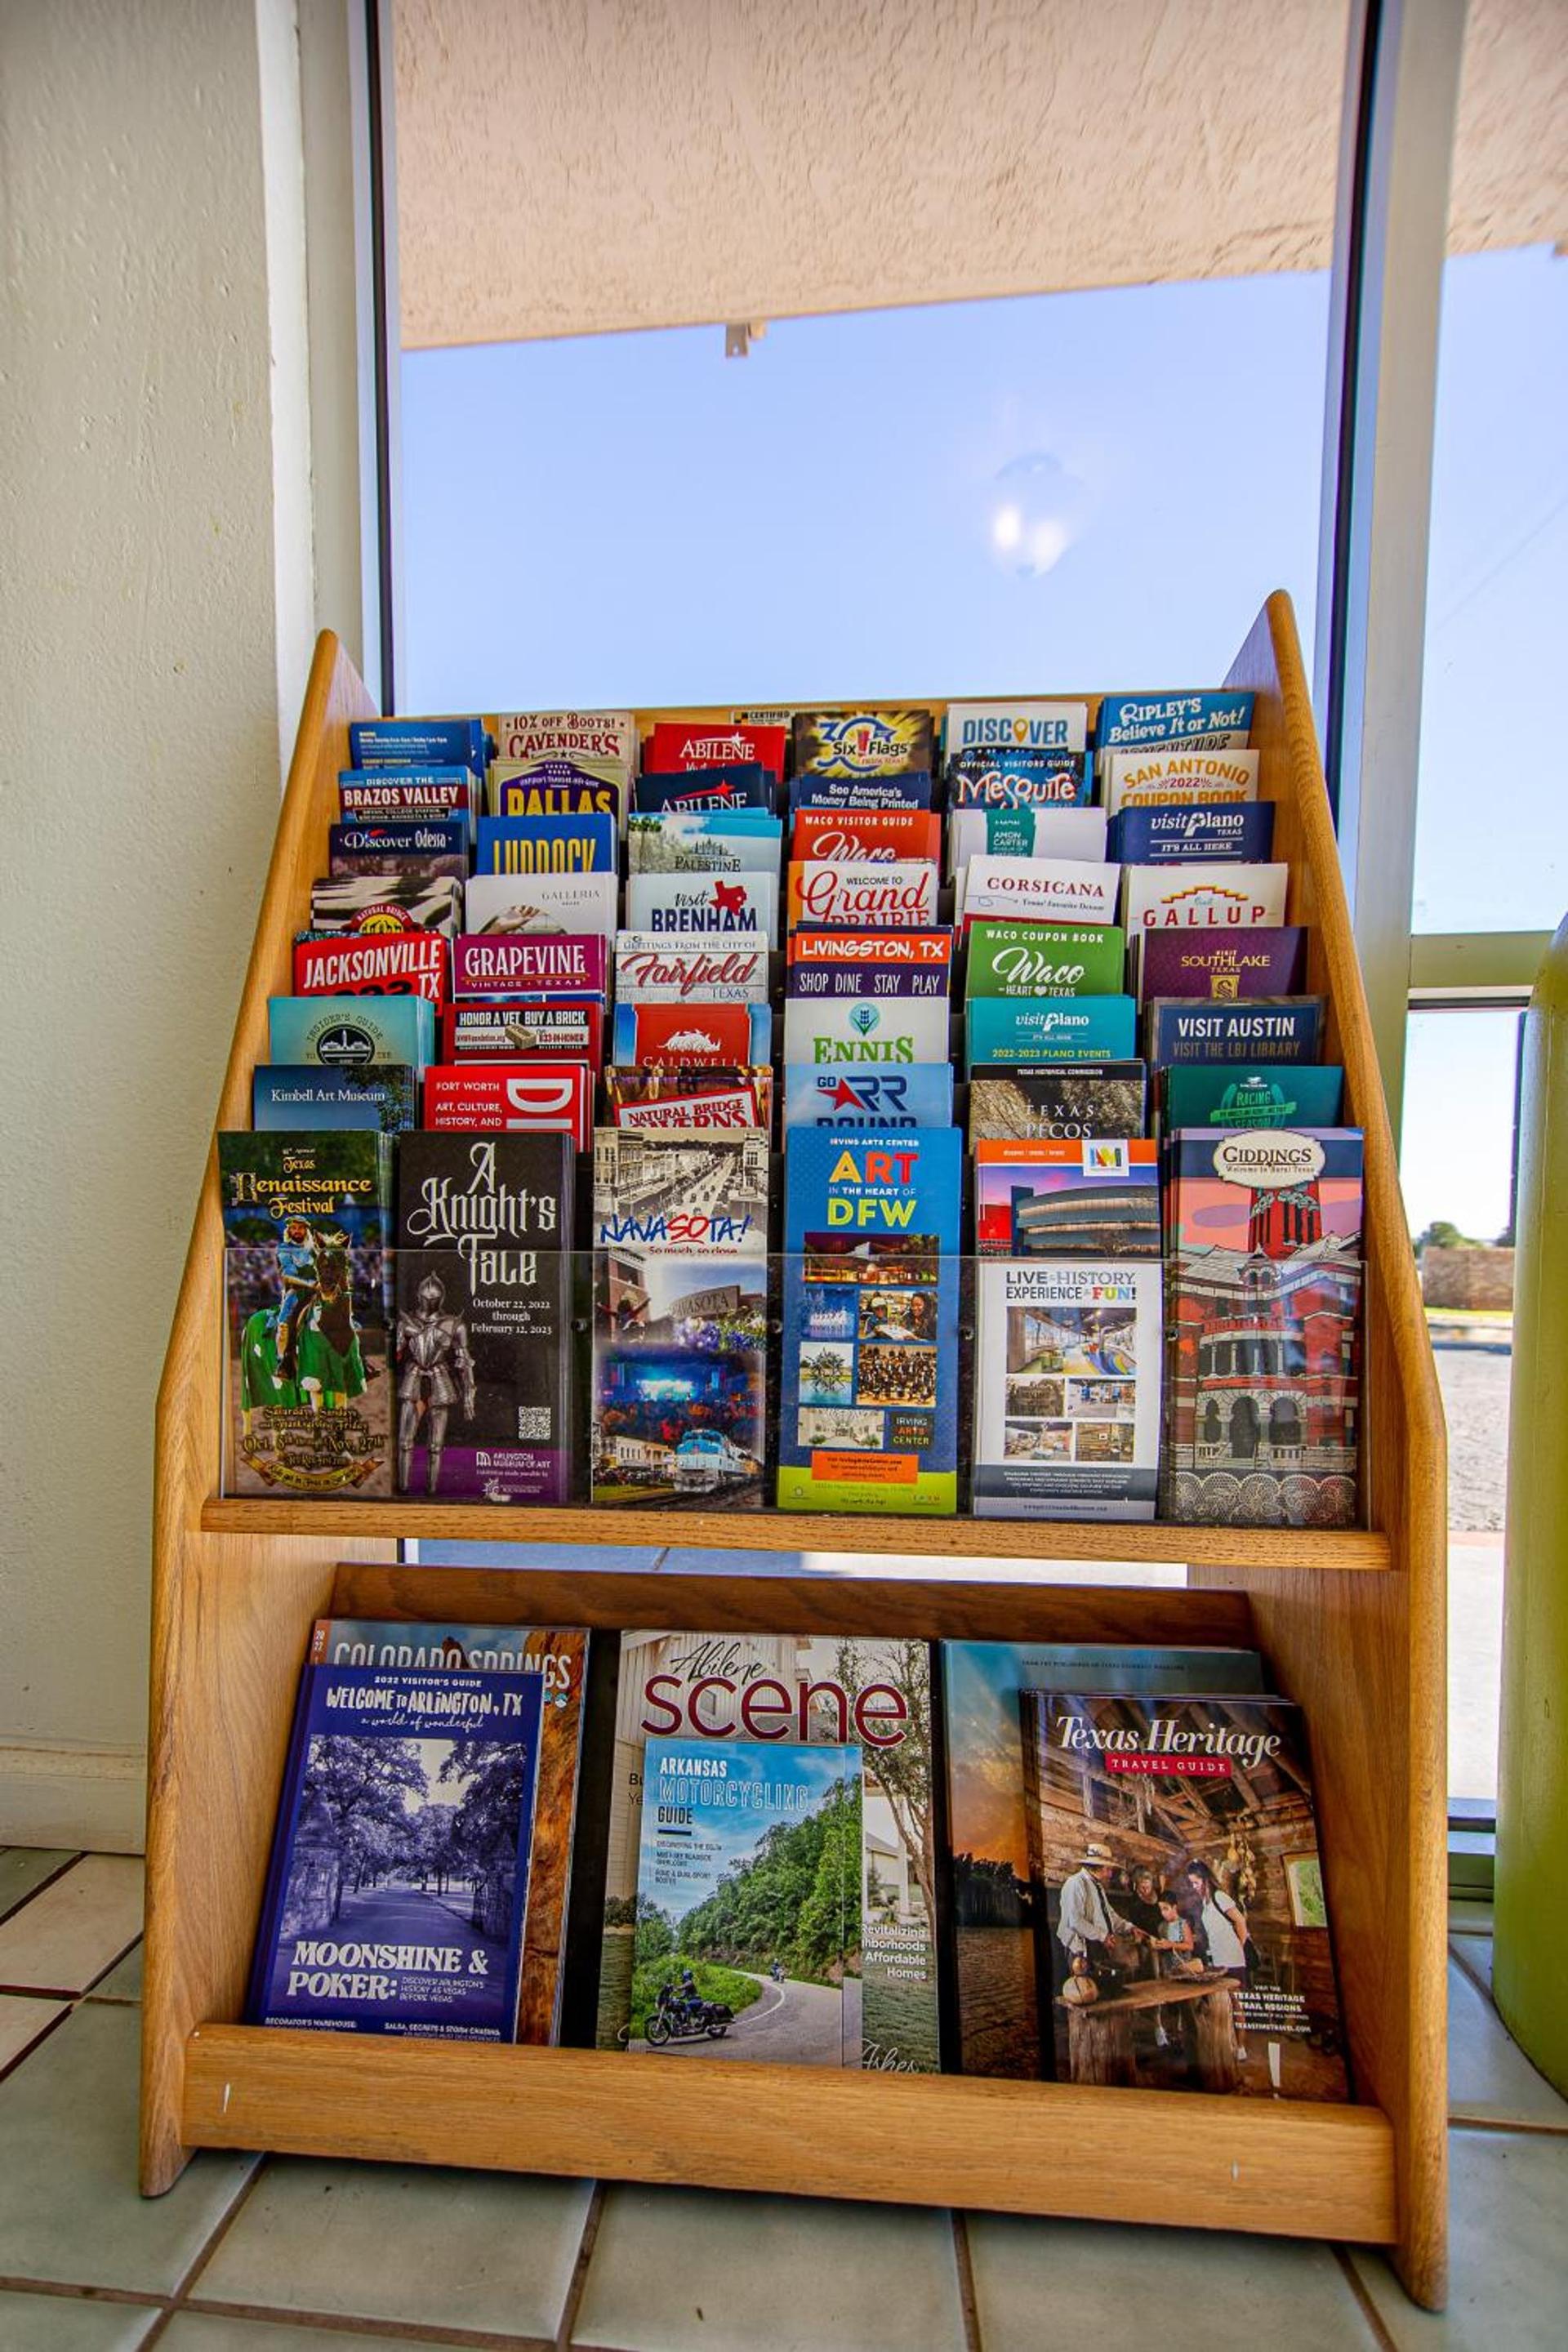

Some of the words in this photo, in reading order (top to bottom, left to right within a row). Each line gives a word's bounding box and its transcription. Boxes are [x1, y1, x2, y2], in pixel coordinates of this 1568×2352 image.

[514, 715, 537, 729] 10%
[542, 716, 564, 727] OFF
[568, 712, 615, 729] BOOTS!
[1108, 723, 1166, 743] Believe
[1169, 716, 1185, 733] It
[1187, 719, 1206, 730] or
[1208, 706, 1245, 729] Not!
[509, 732, 620, 759] CAVENDER'S
[679, 738, 755, 760] ABILENE
[833, 741, 856, 755] Six
[868, 742, 908, 756] Flags
[960, 760, 1001, 768] OFFICIAL
[1004, 760, 1045, 768] VISITORS
[1047, 760, 1075, 768] GUIDE
[366, 777, 412, 786] DISCOVER
[416, 777, 434, 785] THE
[1124, 763, 1162, 789] SAN
[1167, 759, 1250, 786] ANTONIO
[829, 784, 849, 795] See
[851, 786, 902, 798] America's
[1169, 777, 1201, 789] 2022
[344, 788, 400, 806] BRAZOS
[404, 786, 458, 804] VALLEY
[507, 787, 611, 816] DALLAS
[812, 793, 846, 808] Money
[849, 795, 879, 808] Being
[880, 798, 919, 809] Printed
[804, 816, 833, 826] WACO
[837, 817, 878, 826] VISITOR
[882, 817, 914, 826] GUIDE
[344, 831, 412, 849] Discover
[415, 828, 446, 848] Odessa
[994, 839, 1028, 848] CARTER
[1161, 844, 1180, 852] IT'S
[1183, 843, 1202, 851] ALL
[1204, 842, 1232, 850] HERE
[675, 856, 741, 872] PALESTINE
[847, 876, 889, 885] WELCOME
[891, 876, 903, 885] TO
[987, 876, 1104, 898] CORSICANA
[542, 889, 600, 901] GALLERIA
[795, 871, 929, 922] Grand
[652, 907, 758, 933] BRENHAM
[1143, 906, 1265, 927] GALLUP
[986, 929, 1017, 940] WACO
[1022, 931, 1067, 942] COUPON
[1073, 933, 1103, 943] BOOK
[624, 942, 670, 950] GREETINGS
[675, 942, 700, 950] FROM
[723, 942, 742, 950] CITY
[802, 940, 915, 959] LIVINGSTON,
[920, 941, 944, 958] TX
[303, 939, 442, 989] JACKSONVILLE
[465, 945, 586, 977] GRAPEVINE
[992, 947, 1085, 984] Waco
[1181, 955, 1271, 967] SOUTHLAKE
[621, 952, 760, 996] Fairfield
[418, 972, 442, 999] TX
[799, 973, 828, 992] SHOP
[835, 973, 862, 993] DINE
[874, 973, 901, 993] STAY
[912, 974, 940, 995] PLAY
[1005, 985, 1032, 996] HEART
[1049, 987, 1075, 997] TEXAS
[712, 987, 749, 999] TEXAS
[460, 1012, 492, 1026] HONOR
[493, 1012, 501, 1025] A
[502, 1011, 521, 1025] VET
[524, 1012, 545, 1025] BUY
[546, 1012, 554, 1024] A
[556, 1011, 586, 1025] BRICK
[1178, 1018, 1223, 1037] VISIT
[1227, 1017, 1295, 1037] AUSTIN
[813, 1036, 914, 1063] ENNIS
[992, 1049, 1040, 1058] 2022-2023
[1043, 1049, 1075, 1058] PLANO
[1078, 1049, 1111, 1058] EVENTS
[1172, 1042, 1201, 1058] VISIT
[1205, 1041, 1223, 1057] THE
[1227, 1041, 1247, 1057] LBJ
[1251, 1040, 1301, 1057] LIBRARY
[436, 1082, 459, 1091] FORT
[463, 1082, 500, 1092] WORTH
[817, 1076, 837, 1088] GO
[271, 1089, 314, 1102] Kimbell
[317, 1089, 335, 1102] Art
[337, 1089, 385, 1102] Museum
[435, 1103, 455, 1113] ART,
[457, 1103, 502, 1114] CULTURE,
[628, 1106, 689, 1125] NATURAL
[693, 1098, 745, 1116] BRIDGE
[435, 1116, 478, 1128] HISTORY,
[480, 1117, 502, 1127] AND
[1025, 1123, 1092, 1139] PECOS
[830, 1138, 859, 1146] IRVING
[885, 1138, 919, 1147] CENTER
[1223, 1146, 1312, 1163] GIDDINGS
[283, 1156, 315, 1174] Texas
[467, 1142, 497, 1194] A
[829, 1150, 919, 1183] ART
[229, 1172, 372, 1206] Renaissance
[828, 1187, 839, 1195] IN
[842, 1186, 862, 1196] THE
[865, 1187, 899, 1196] HEART
[902, 1187, 916, 1196] OF
[269, 1196, 336, 1219] Festival
[407, 1176, 557, 1247] Knight's
[827, 1198, 917, 1227] DFW
[600, 1213, 754, 1243] NAVASOTA!
[1006, 1272, 1048, 1284] LIVE
[1006, 1287, 1083, 1299] EXPERIENCE
[1092, 1287, 1137, 1300] FUN!
[472, 1297, 511, 1308] October
[513, 1301, 528, 1310] 22,
[529, 1301, 550, 1309] 2022
[492, 1312, 531, 1322] through
[471, 1323, 512, 1335] February
[516, 1325, 529, 1334] 12,
[531, 1325, 552, 1335] 2023
[896, 1417, 928, 1427] IRVING
[898, 1427, 925, 1435] ARTS
[893, 1436, 929, 1446] CENTER
[493, 1452, 534, 1460] ARLINGTON
[493, 1459, 524, 1468] MUSEUM
[536, 1460, 550, 1468] ART
[670, 1641, 769, 1685] Abilene
[374, 1676, 399, 1685] 2022
[403, 1677, 449, 1686] VISITOR'S
[452, 1678, 483, 1688] GUIDE
[327, 1686, 395, 1710] WELCOME
[396, 1694, 408, 1708] TO
[503, 1693, 523, 1716] TX
[640, 1673, 908, 1748] scene
[1056, 1716, 1139, 1751] Texas
[1147, 1719, 1281, 1769] Heritage
[660, 1757, 728, 1777] ARKANSAS
[1111, 1758, 1169, 1771] TRAVEL
[1177, 1761, 1227, 1772] GUIDE
[658, 1776, 809, 1812] MOTORCYCLING
[657, 1805, 693, 1824] GUIDE
[861, 1923, 925, 1939] Revitalizing
[292, 1940, 463, 1975] MOONSHINE
[468, 1949, 488, 1975] &
[865, 1951, 926, 1967] Affordable
[887, 1967, 927, 1980] Homes
[287, 1971, 398, 2001] POKER:
[1233, 1992, 1261, 2001] TEXAS
[1263, 1993, 1306, 2003] HERITAGE
